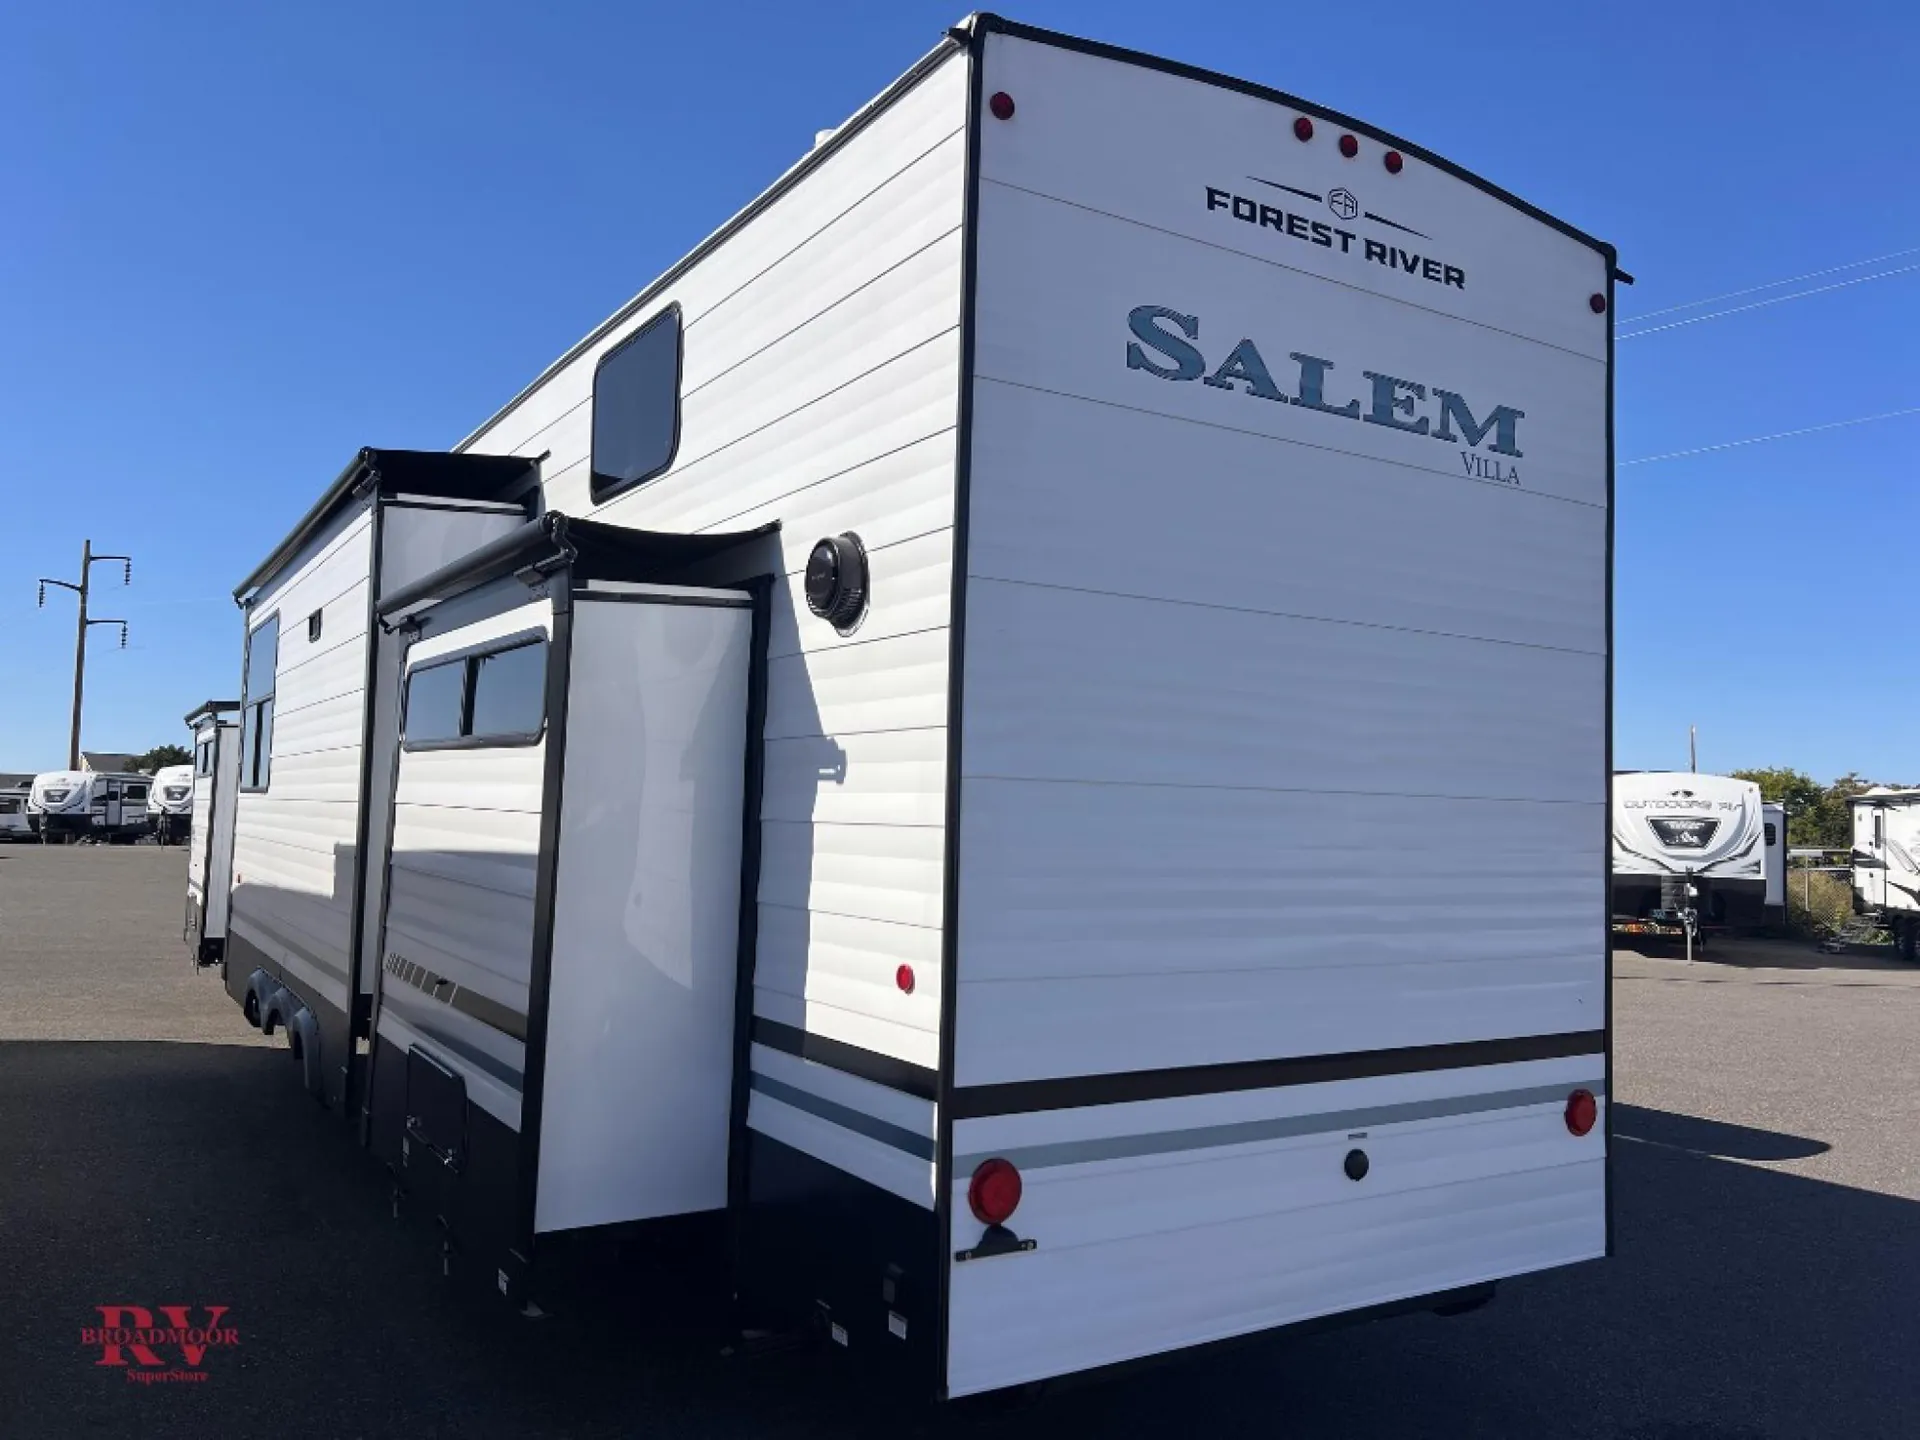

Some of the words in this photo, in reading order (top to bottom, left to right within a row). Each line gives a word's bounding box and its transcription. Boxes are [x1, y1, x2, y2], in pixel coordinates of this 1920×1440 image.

[1205, 186, 1356, 254] FOREST
[1364, 238, 1466, 290] RIVER
[1126, 305, 1526, 458] SALEM
[1460, 452, 1521, 486] VILLA
